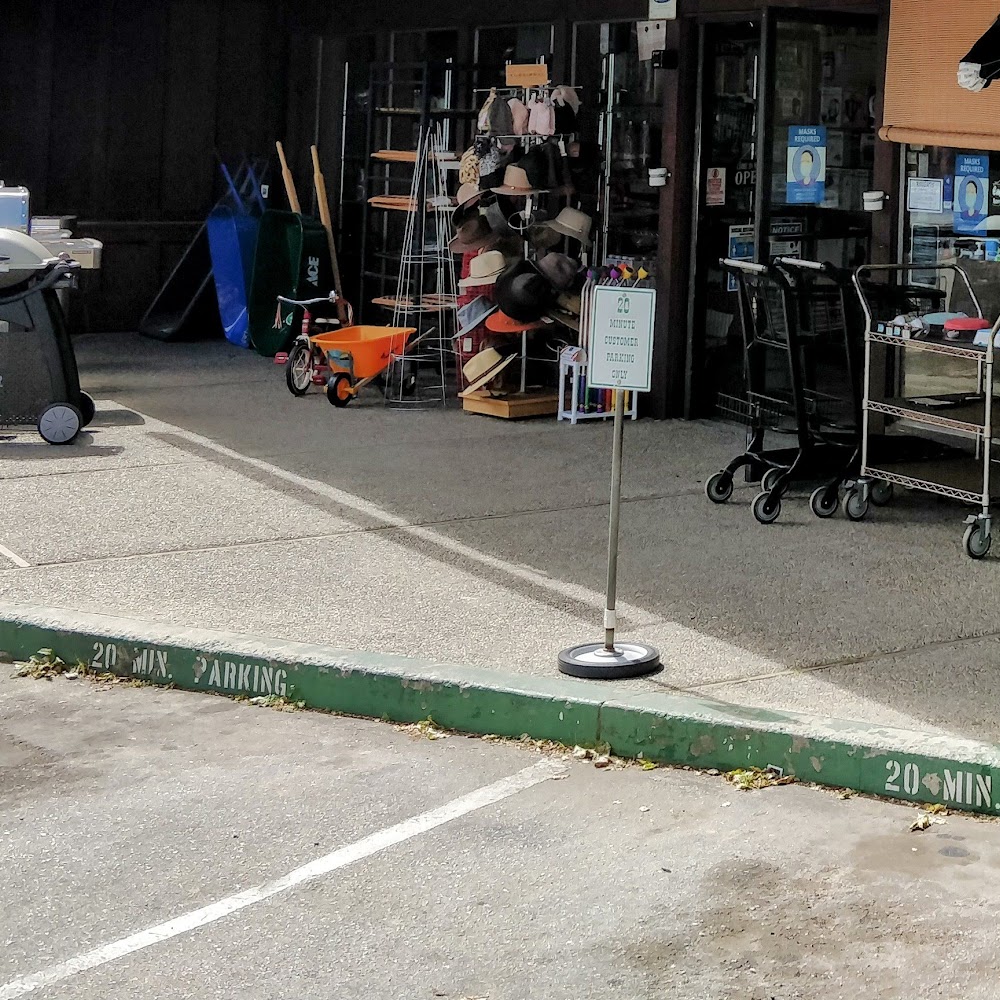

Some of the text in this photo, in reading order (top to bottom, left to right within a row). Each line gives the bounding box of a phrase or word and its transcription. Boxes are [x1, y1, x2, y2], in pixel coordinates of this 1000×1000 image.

[794, 135, 820, 143] REQUIRED
[963, 157, 980, 165] MASKS
[960, 165, 984, 173] REQUIRED
[735, 170, 757, 185] OPE
[772, 226, 800, 234] NOTICE
[306, 255, 320, 287] ACE
[617, 297, 630, 313] 20
[609, 318, 636, 329] MINUTE
[604, 335, 639, 347] CUSTOMER
[606, 352, 635, 363] PARKING
[611, 369, 628, 380] ONLY
[92, 642, 116, 669] 20
[193, 656, 287, 696] PARKING
[884, 760, 919, 795] 20
[943, 769, 1000, 810] MIN.
